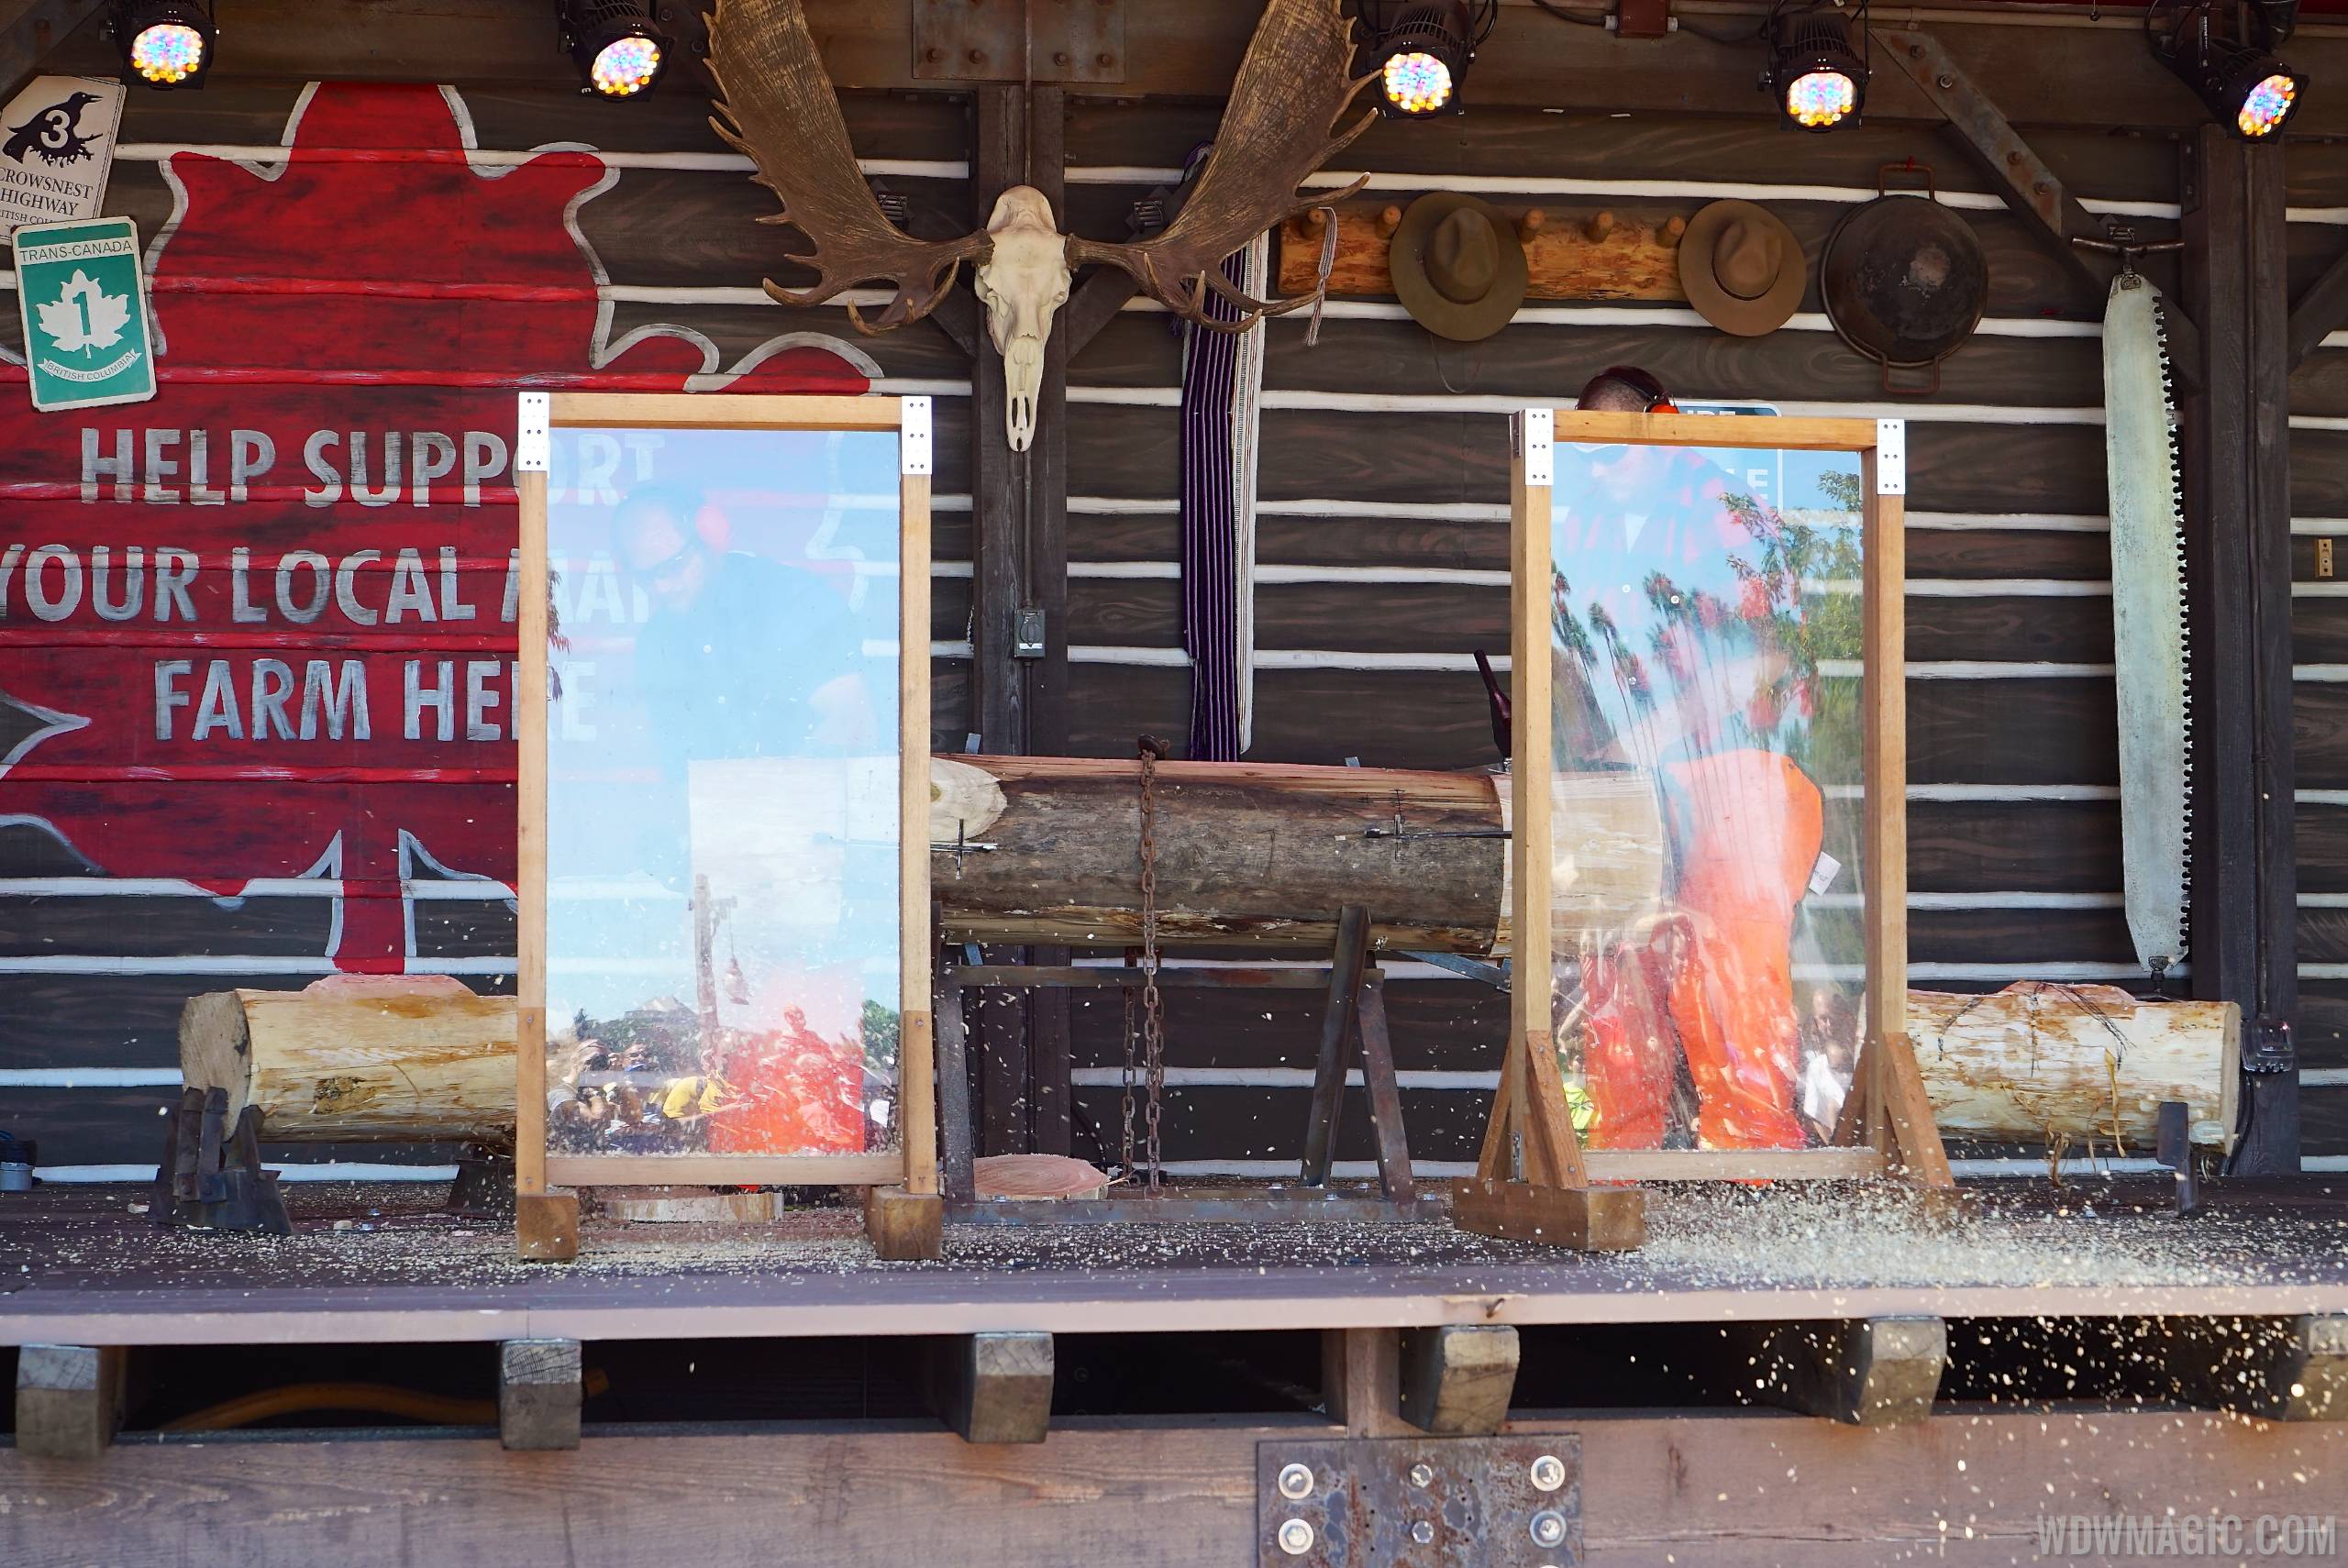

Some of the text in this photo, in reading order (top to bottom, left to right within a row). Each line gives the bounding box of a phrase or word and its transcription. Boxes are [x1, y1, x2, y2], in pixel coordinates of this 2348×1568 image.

[40, 110, 71, 149] 3
[0, 167, 93, 200] CROWSNEST
[1, 188, 79, 216] HIGHWAY
[21, 239, 133, 262] TRANS-CANADA
[72, 291, 92, 336] 1
[47, 355, 134, 381] BRITISH COLUMBIA
[80, 428, 276, 505] HELP
[232, 546, 476, 625] LOCAL
[154, 658, 371, 741] FARM
